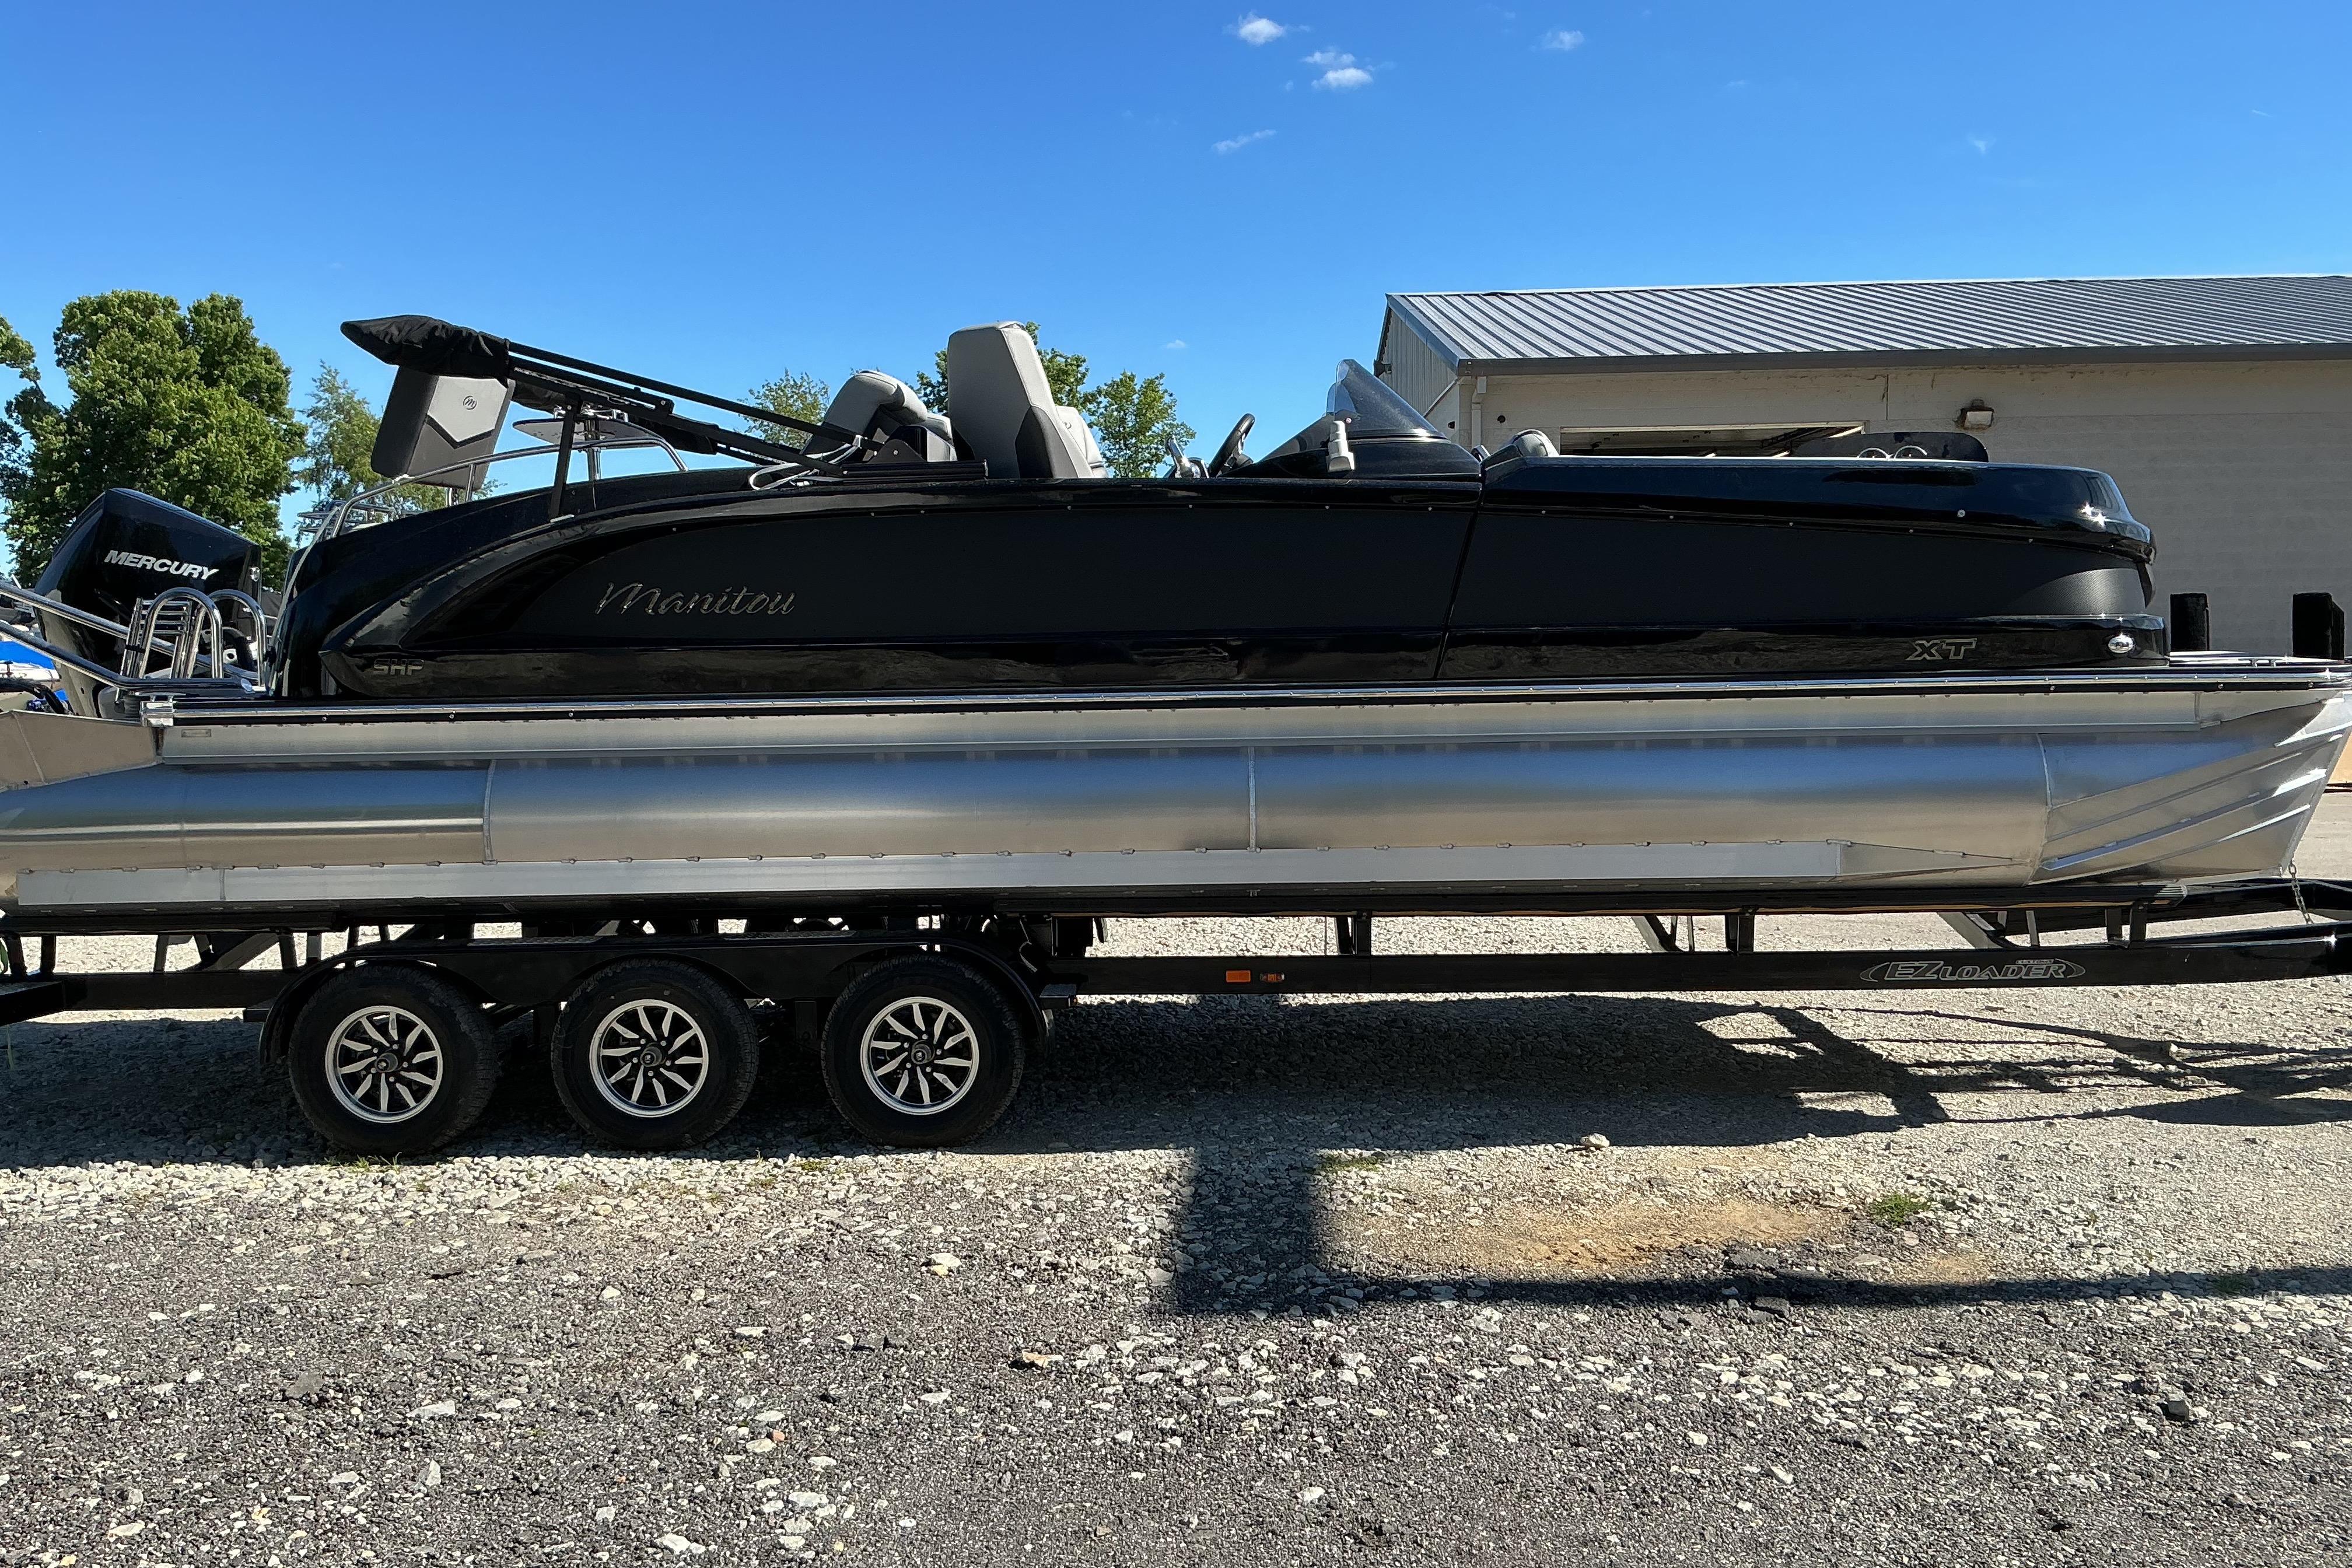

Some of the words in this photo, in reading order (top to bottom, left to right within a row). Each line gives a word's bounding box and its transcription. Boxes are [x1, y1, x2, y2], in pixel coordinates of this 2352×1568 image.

[104, 550, 220, 580] MERCURY
[594, 582, 795, 615] Manitou
[1905, 638, 1978, 661] XT
[373, 658, 425, 676] SHP
